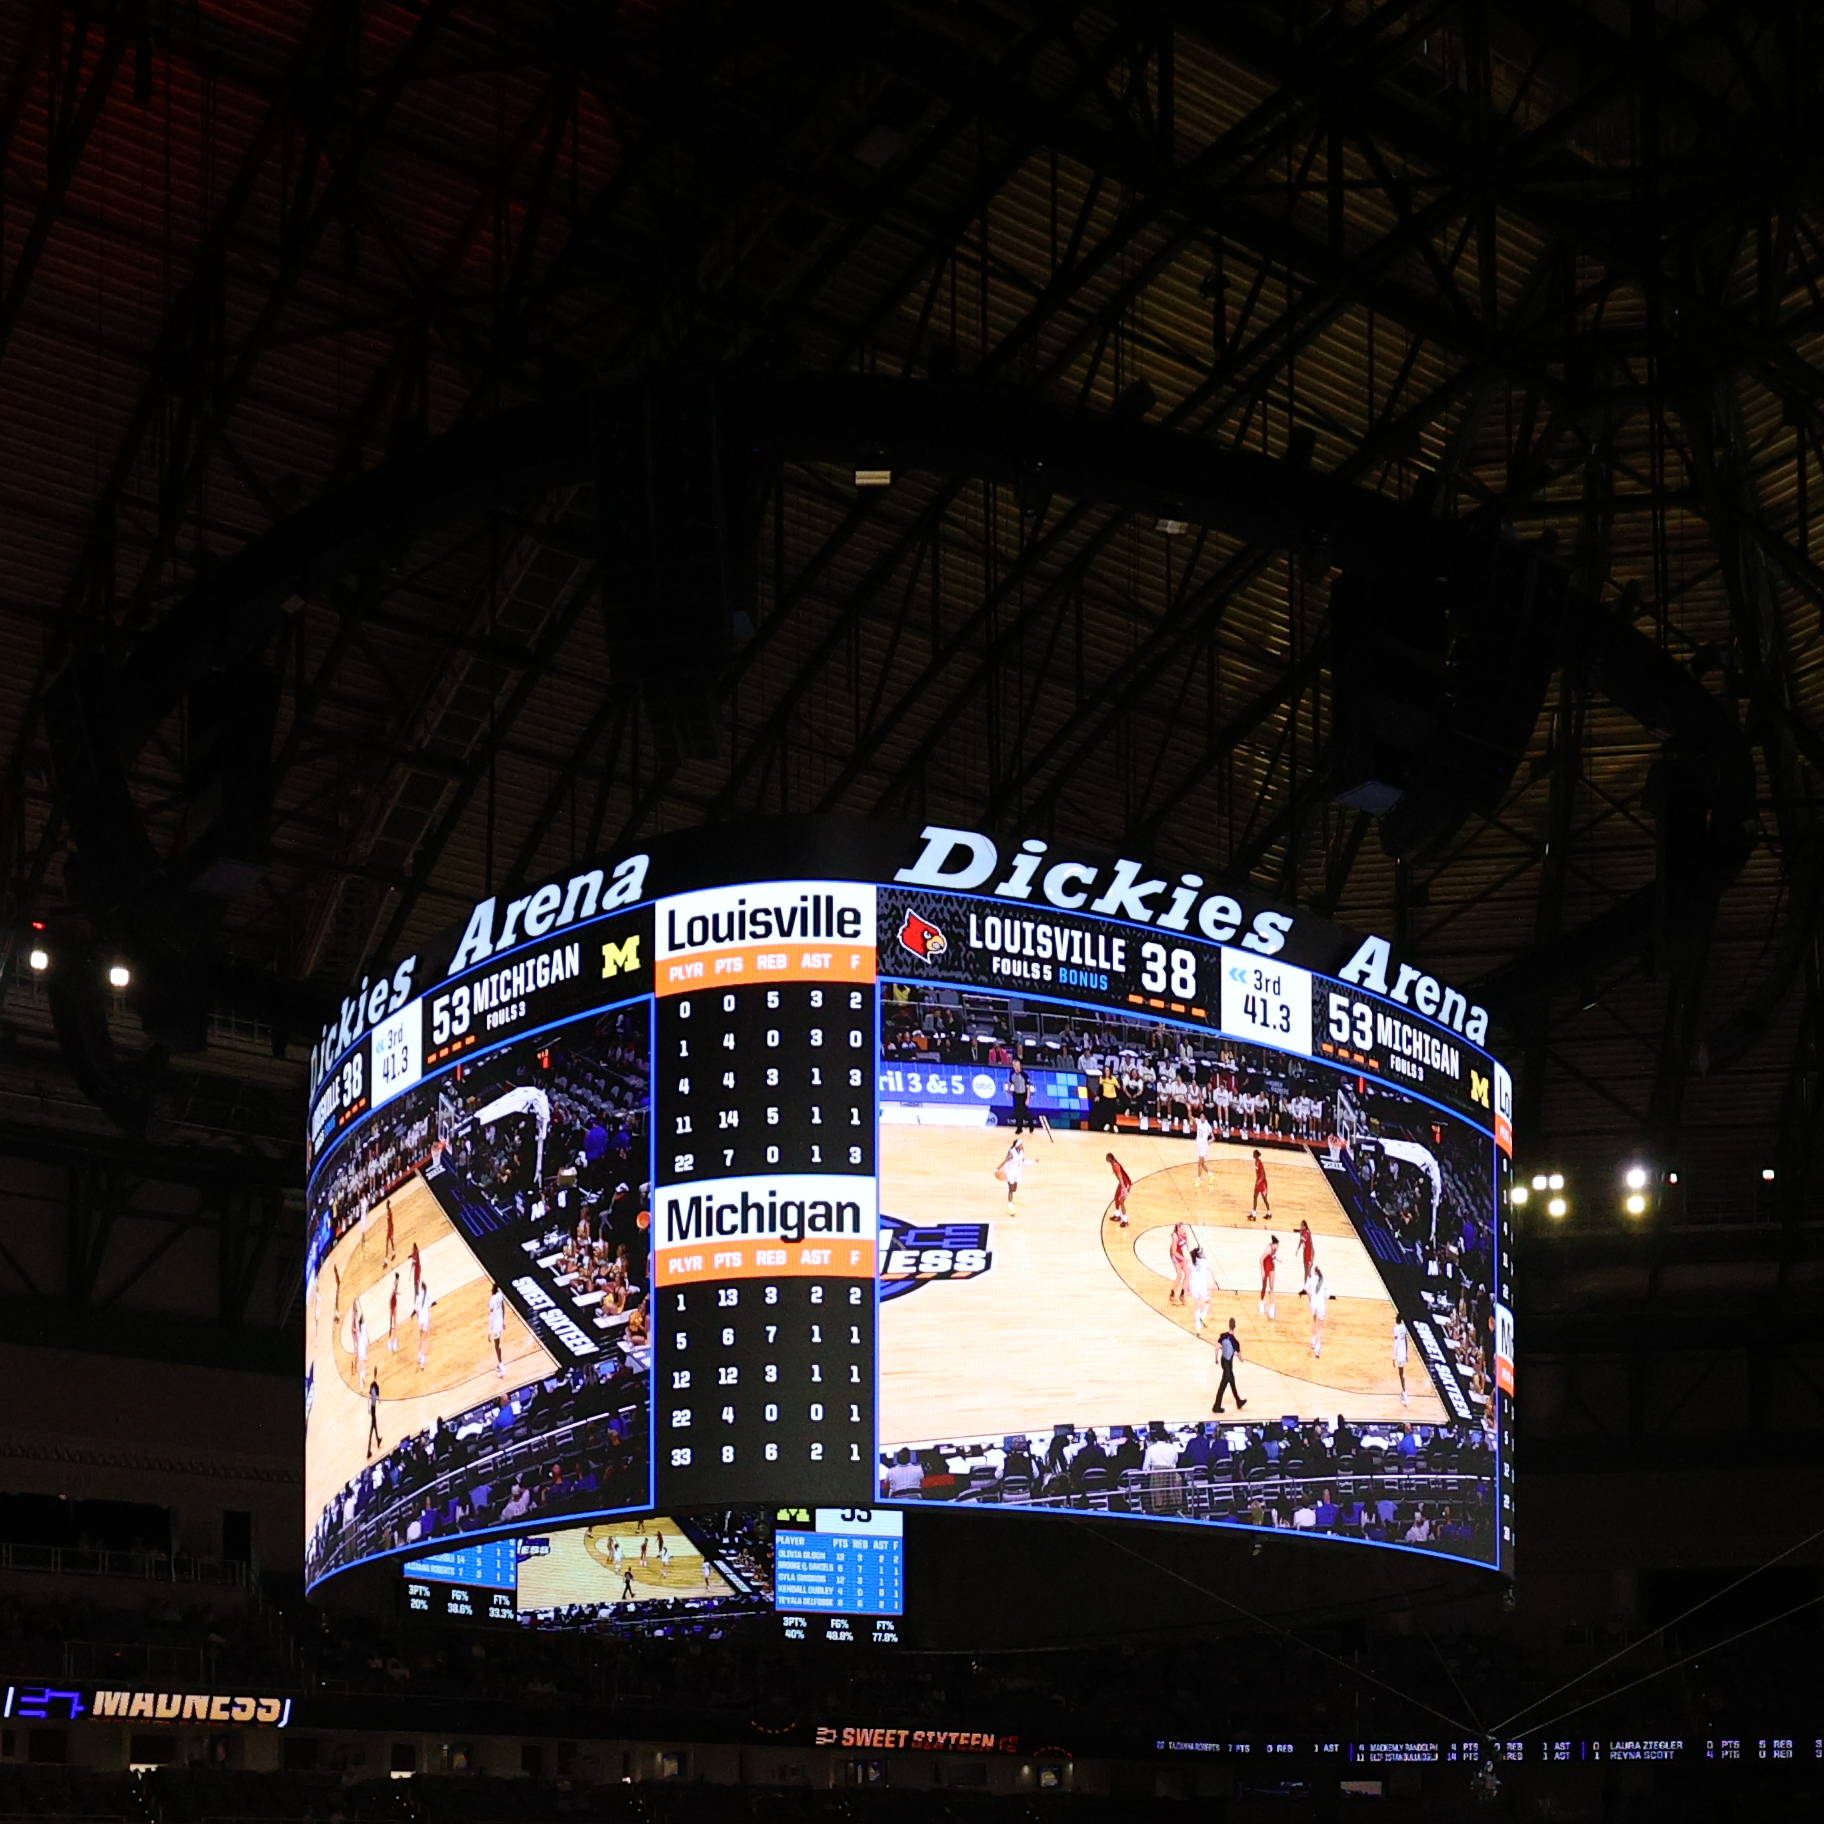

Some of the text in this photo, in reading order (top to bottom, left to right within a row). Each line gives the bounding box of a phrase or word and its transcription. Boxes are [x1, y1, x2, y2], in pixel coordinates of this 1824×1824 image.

[447, 853, 651, 976] Arena
[666, 893, 861, 951] Louisville
[894, 825, 1490, 1048] Dickies Arena
[668, 953, 860, 981] PLYR PTS REB AST F
[968, 911, 1198, 1001] LOUISVILLE 38
[991, 955, 1109, 992] FOULS 5 BONUS
[1252, 966, 1282, 998] 3rd
[431, 934, 641, 1046] 53 MICHIGAN M
[680, 990, 861, 1018] 0 0 5 3 2
[485, 1003, 527, 1032] FOULS 3
[1242, 993, 1293, 1035] 41.3
[387, 1021, 404, 1051] 3rd
[680, 1029, 862, 1056] 1 4 0 3 0
[382, 1045, 409, 1084] 41.3
[1327, 993, 1491, 1110] 53 MICHIGAN M
[342, 1052, 363, 1108] 38
[1389, 1053, 1417, 1079] FOULS
[679, 1068, 861, 1094] 4 4 3 1 3
[906, 1072, 922, 1094] 3
[925, 1073, 949, 1095] &
[950, 1074, 966, 1095] 5
[676, 1107, 860, 1134] 11 14 5 1 1
[675, 1146, 861, 1172] 22 7 0 1 3
[667, 1190, 860, 1243] Michigan
[669, 1250, 860, 1274] PLYR PTS REB AST F
[677, 1286, 861, 1311] 1 13 3 2 2
[511, 1275, 600, 1356] SWEET SIXTEEN
[677, 1325, 860, 1349] 5 6 7 1 1
[673, 1365, 860, 1388] 12 12 3 1 1
[672, 1404, 860, 1427] 22 4 0 0 1
[672, 1443, 860, 1466] 33 8 6 2 1
[841, 1726, 996, 1754] SWEET SIXTEEN
[1609, 1740, 1684, 1751] LAURA ZIEGLER
[1609, 1750, 1676, 1760] REYNA SCOTT
